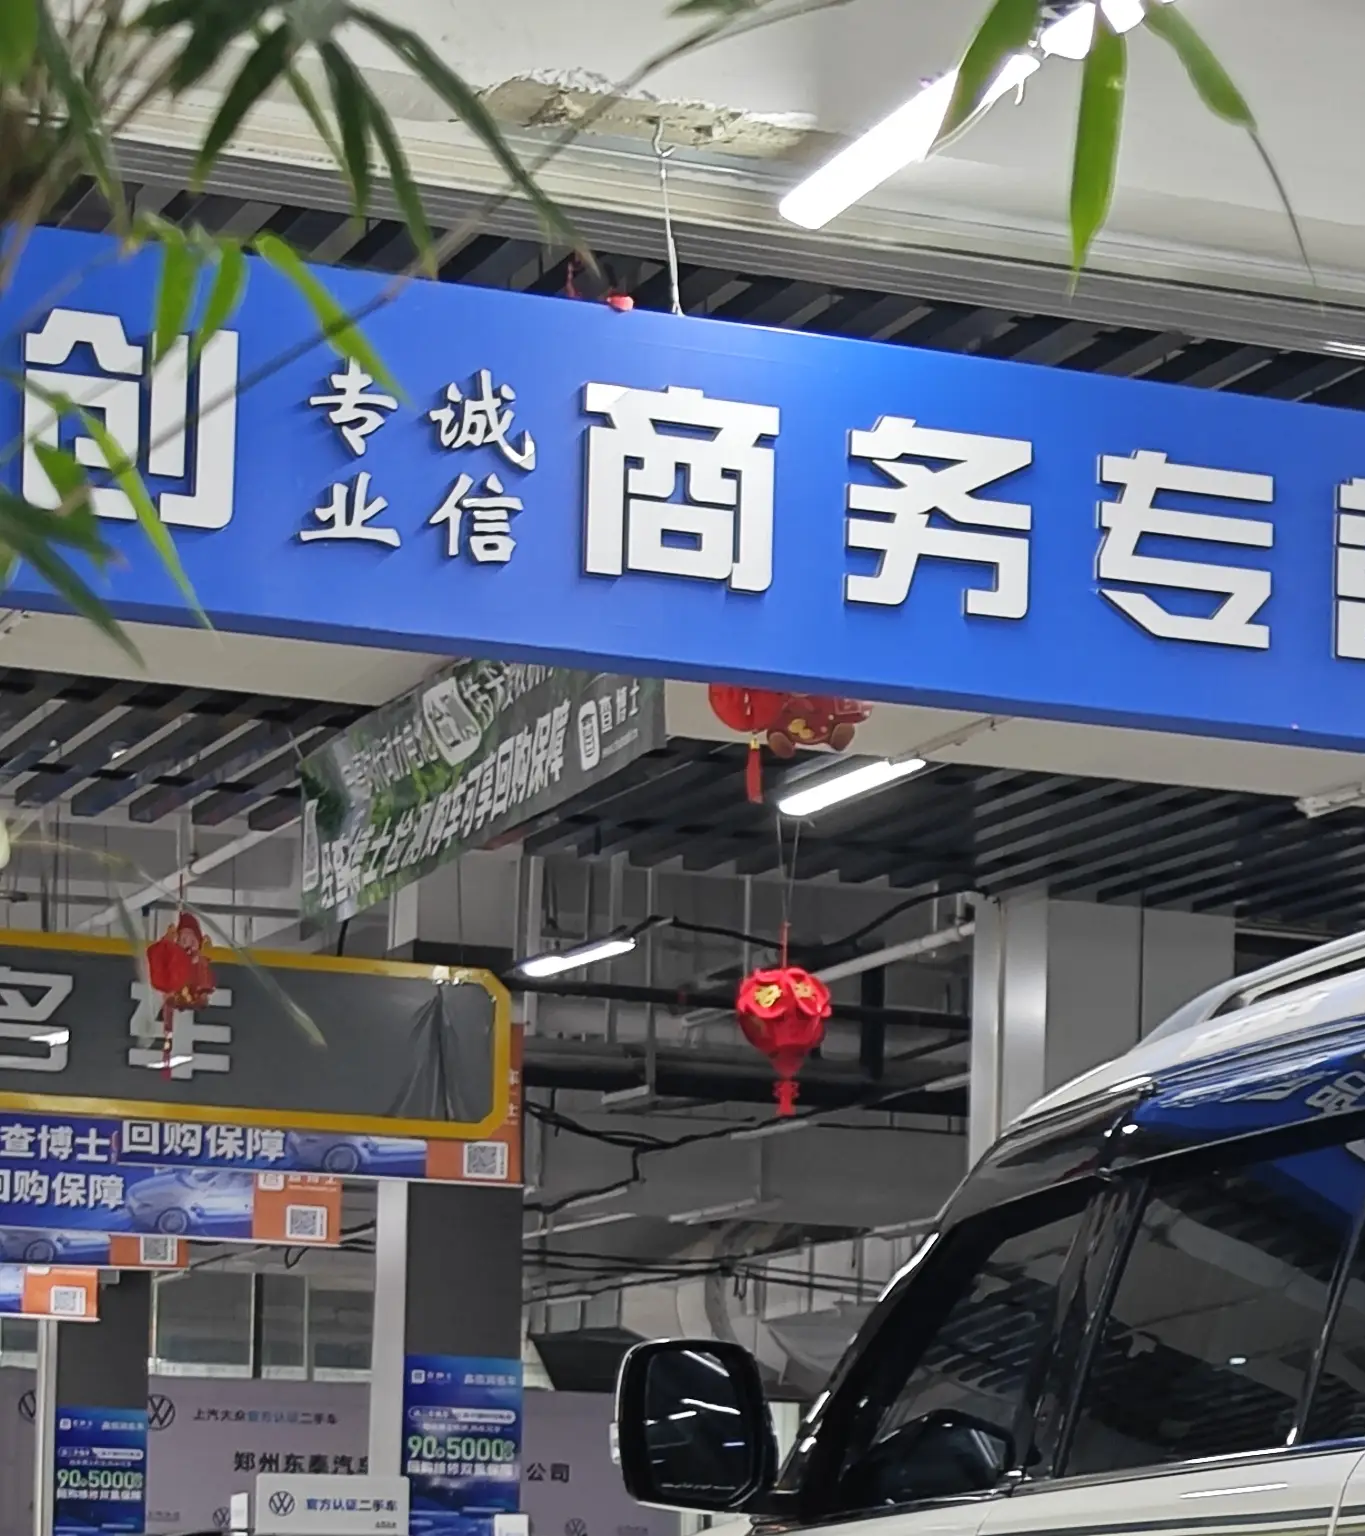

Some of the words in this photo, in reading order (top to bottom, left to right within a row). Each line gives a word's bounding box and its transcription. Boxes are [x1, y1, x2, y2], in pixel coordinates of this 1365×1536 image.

[23, 308, 239, 529] 创
[0, 1123, 110, 1164] 查博士
[122, 1119, 286, 1163] 回购保障
[526, 1462, 570, 1483] 公司
[306, 1498, 398, 1512] 官方认证二手车
